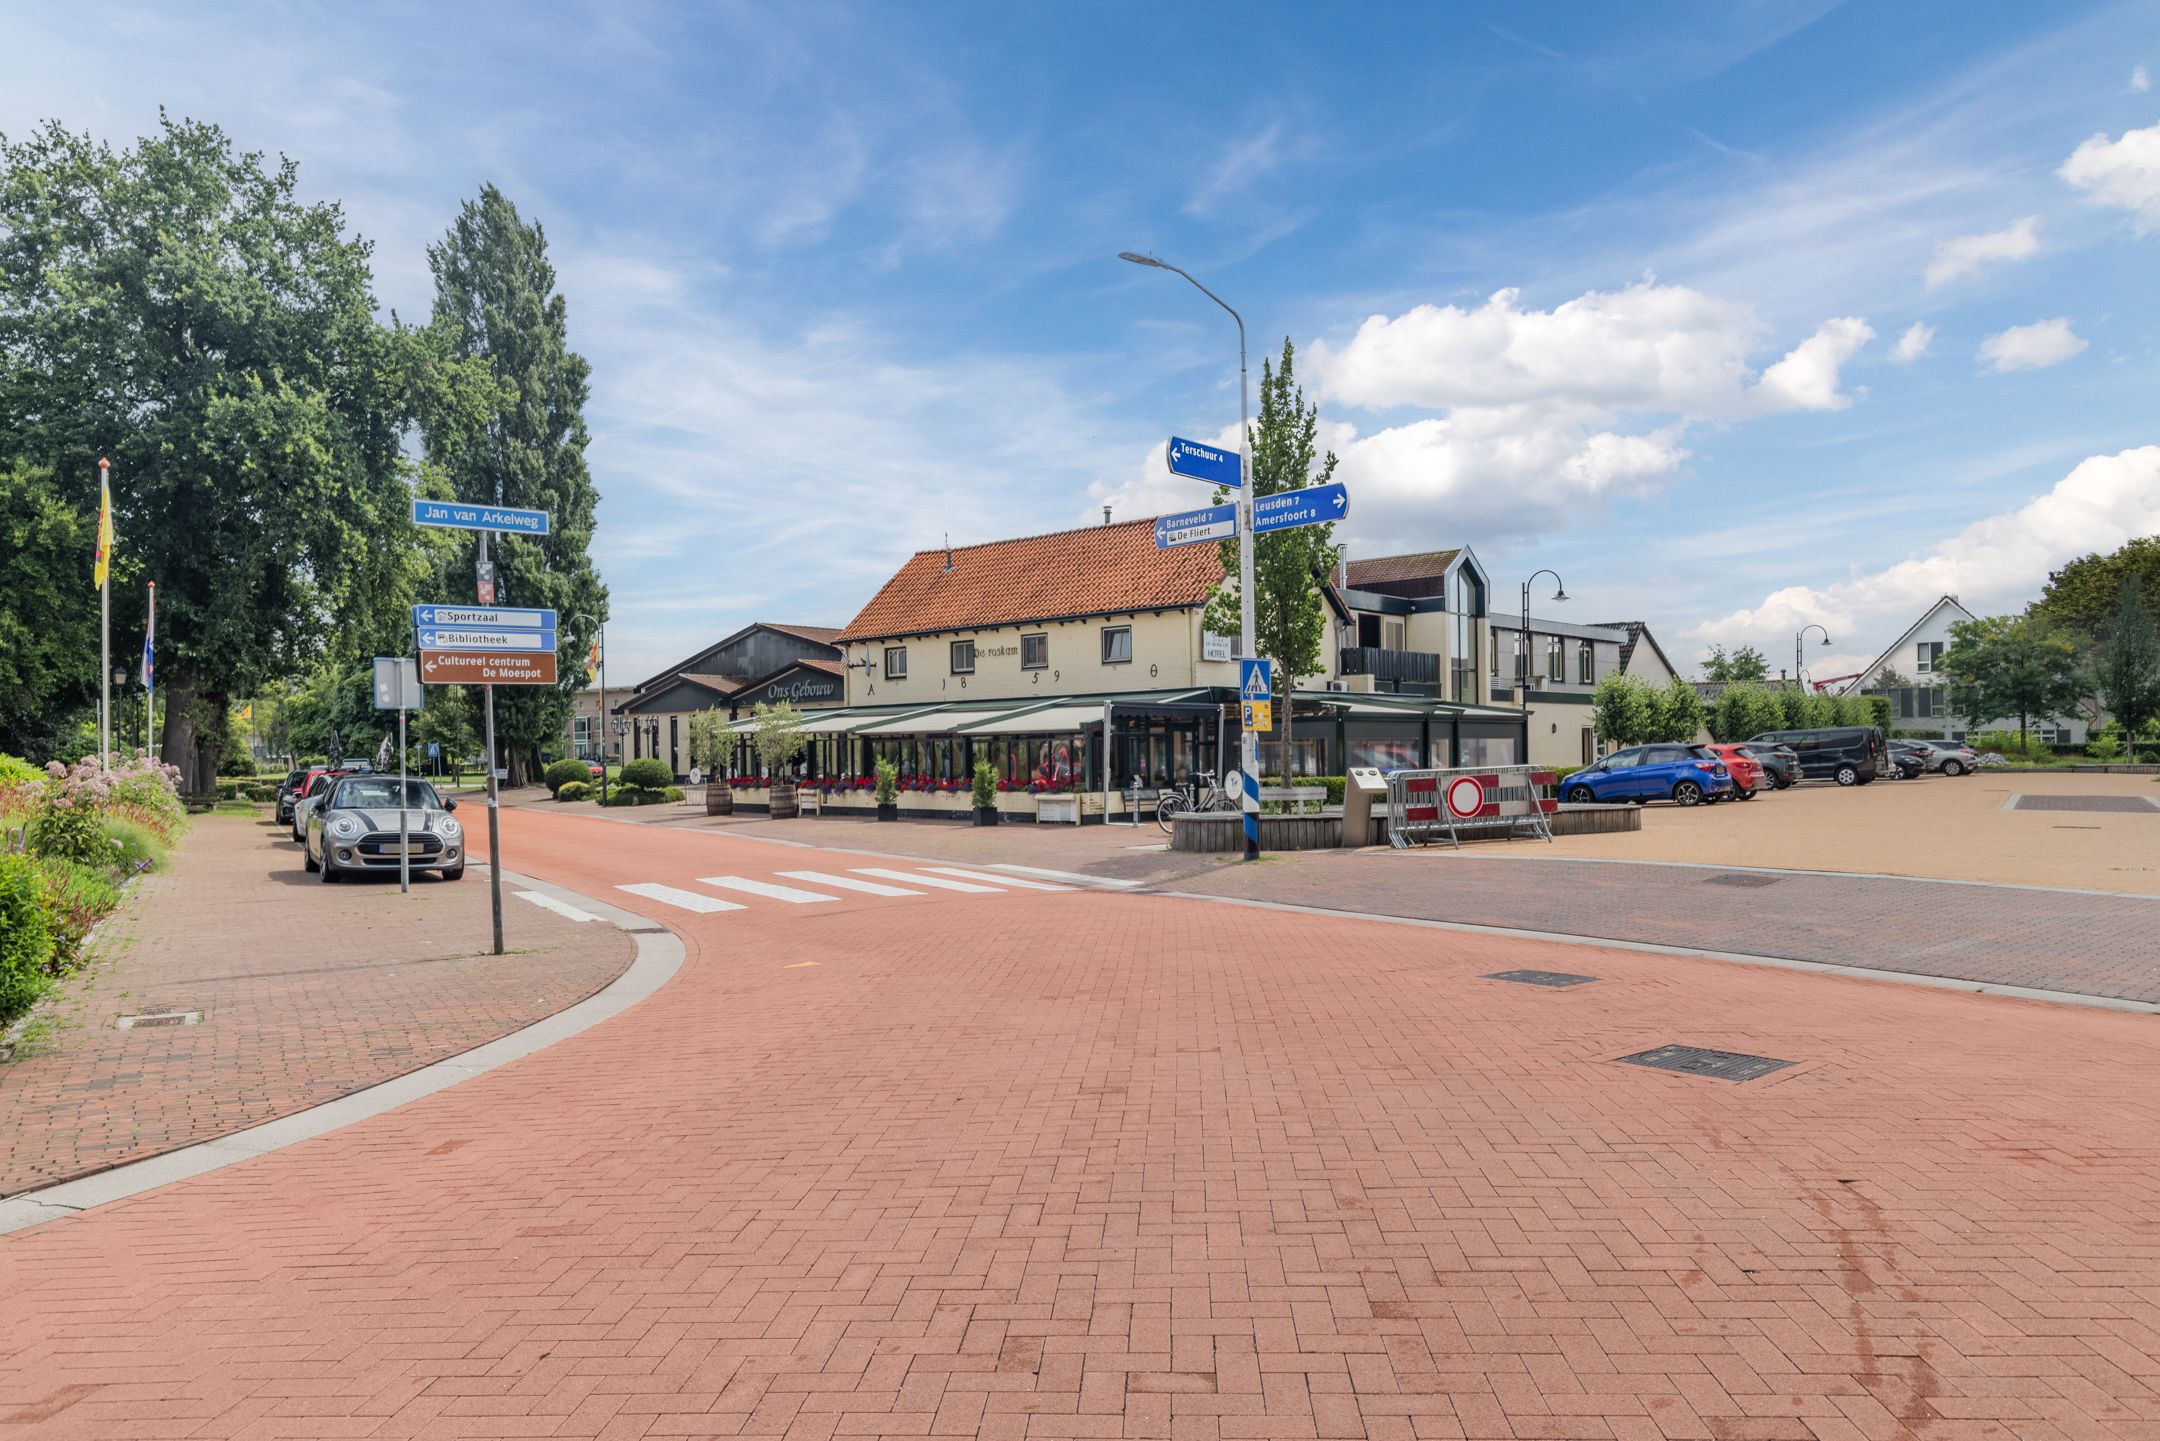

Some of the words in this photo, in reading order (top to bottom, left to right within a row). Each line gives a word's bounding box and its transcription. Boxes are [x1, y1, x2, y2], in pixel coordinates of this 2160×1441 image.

[1180, 442, 1217, 461] Terschuur
[1218, 454, 1223, 463] 4
[1256, 498, 1292, 512] Leusden
[1294, 496, 1300, 504] 7
[424, 506, 448, 519] Jan
[454, 510, 476, 521] van
[482, 511, 538, 529] Arkelweg
[1166, 512, 1206, 528] Barneveld
[1208, 513, 1212, 521] 7
[1256, 509, 1307, 526] Amersfoort
[1310, 508, 1316, 517] 8
[1178, 531, 1187, 540] De
[1190, 527, 1211, 538] Fliert
[448, 612, 498, 622] Sportzaal
[448, 634, 508, 644] Bibliotheek
[988, 645, 1018, 656] roskam
[1208, 650, 1226, 658] HOTEL
[438, 656, 486, 666] Cultureel
[489, 656, 530, 666] centrum
[483, 668, 496, 677] De
[500, 669, 541, 680] Moespot
[768, 684, 790, 698] Ons
[792, 679, 834, 702] Gebouw
[1245, 707, 1251, 718] P
